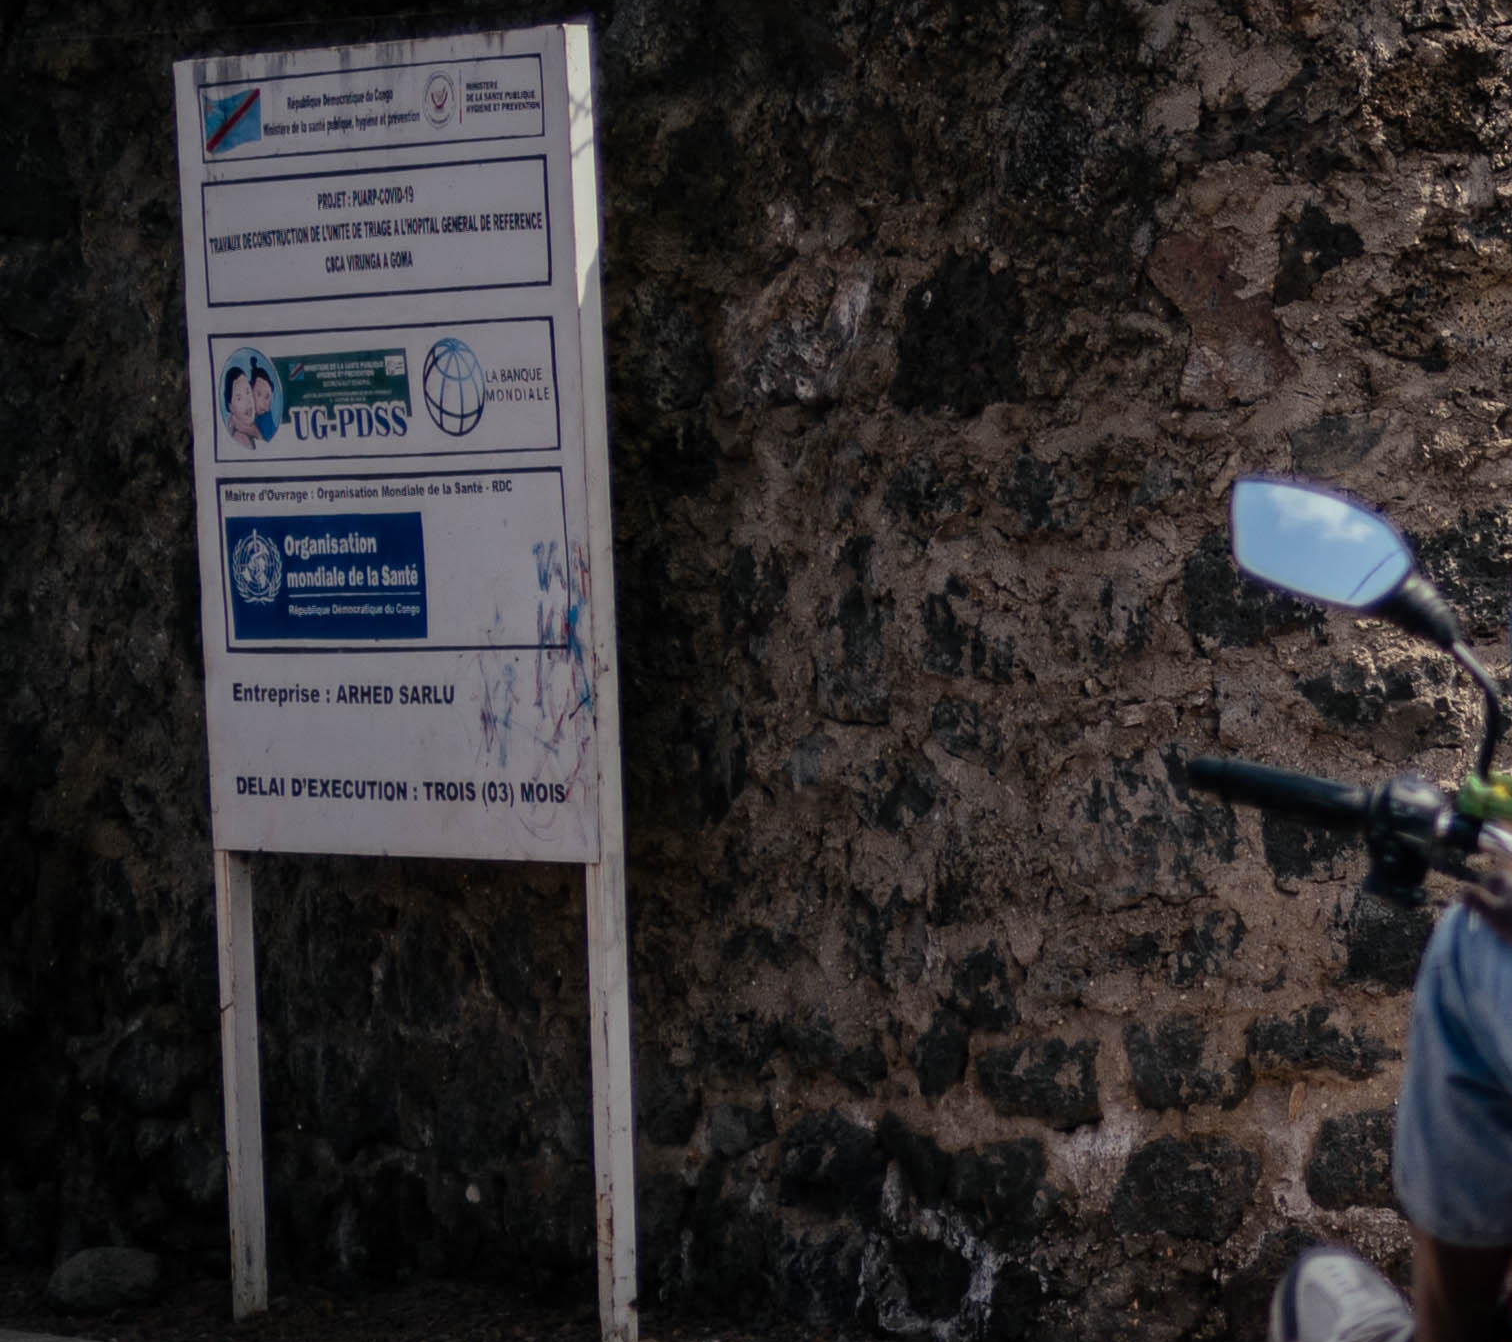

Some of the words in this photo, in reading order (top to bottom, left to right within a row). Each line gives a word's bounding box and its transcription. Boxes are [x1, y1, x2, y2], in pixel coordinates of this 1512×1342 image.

[317, 190, 348, 211] PROJET
[310, 225, 321, 243] DE
[351, 221, 362, 240] DE
[441, 213, 479, 234] GENERAL
[479, 213, 491, 232] DE
[493, 211, 543, 232] REFERENCE
[390, 250, 414, 269] GOMA
[485, 369, 499, 384] LA
[500, 367, 543, 383] BANQUE
[485, 386, 551, 402] MONDIALE
[289, 402, 409, 441] UG-PDSS
[317, 486, 379, 502] Organisation
[381, 484, 425, 498] Mondiale
[427, 483, 440, 496] de
[441, 483, 453, 496] la
[491, 480, 513, 493] RDC
[284, 532, 378, 561] Organisation
[287, 565, 346, 589] mondiale
[348, 566, 365, 588] de
[366, 565, 380, 587] la
[381, 563, 419, 587] Santé
[384, 603, 395, 616] du
[396, 602, 421, 617] Congo
[232, 682, 320, 707] Entreprise
[336, 684, 394, 706] ARHED
[399, 684, 456, 706] SARLU
[236, 775, 286, 798] DELAI
[291, 777, 408, 802] D'EXECUTION
[422, 780, 477, 803] TROIS
[481, 780, 516, 809] (03)
[520, 781, 567, 805] MOIS
